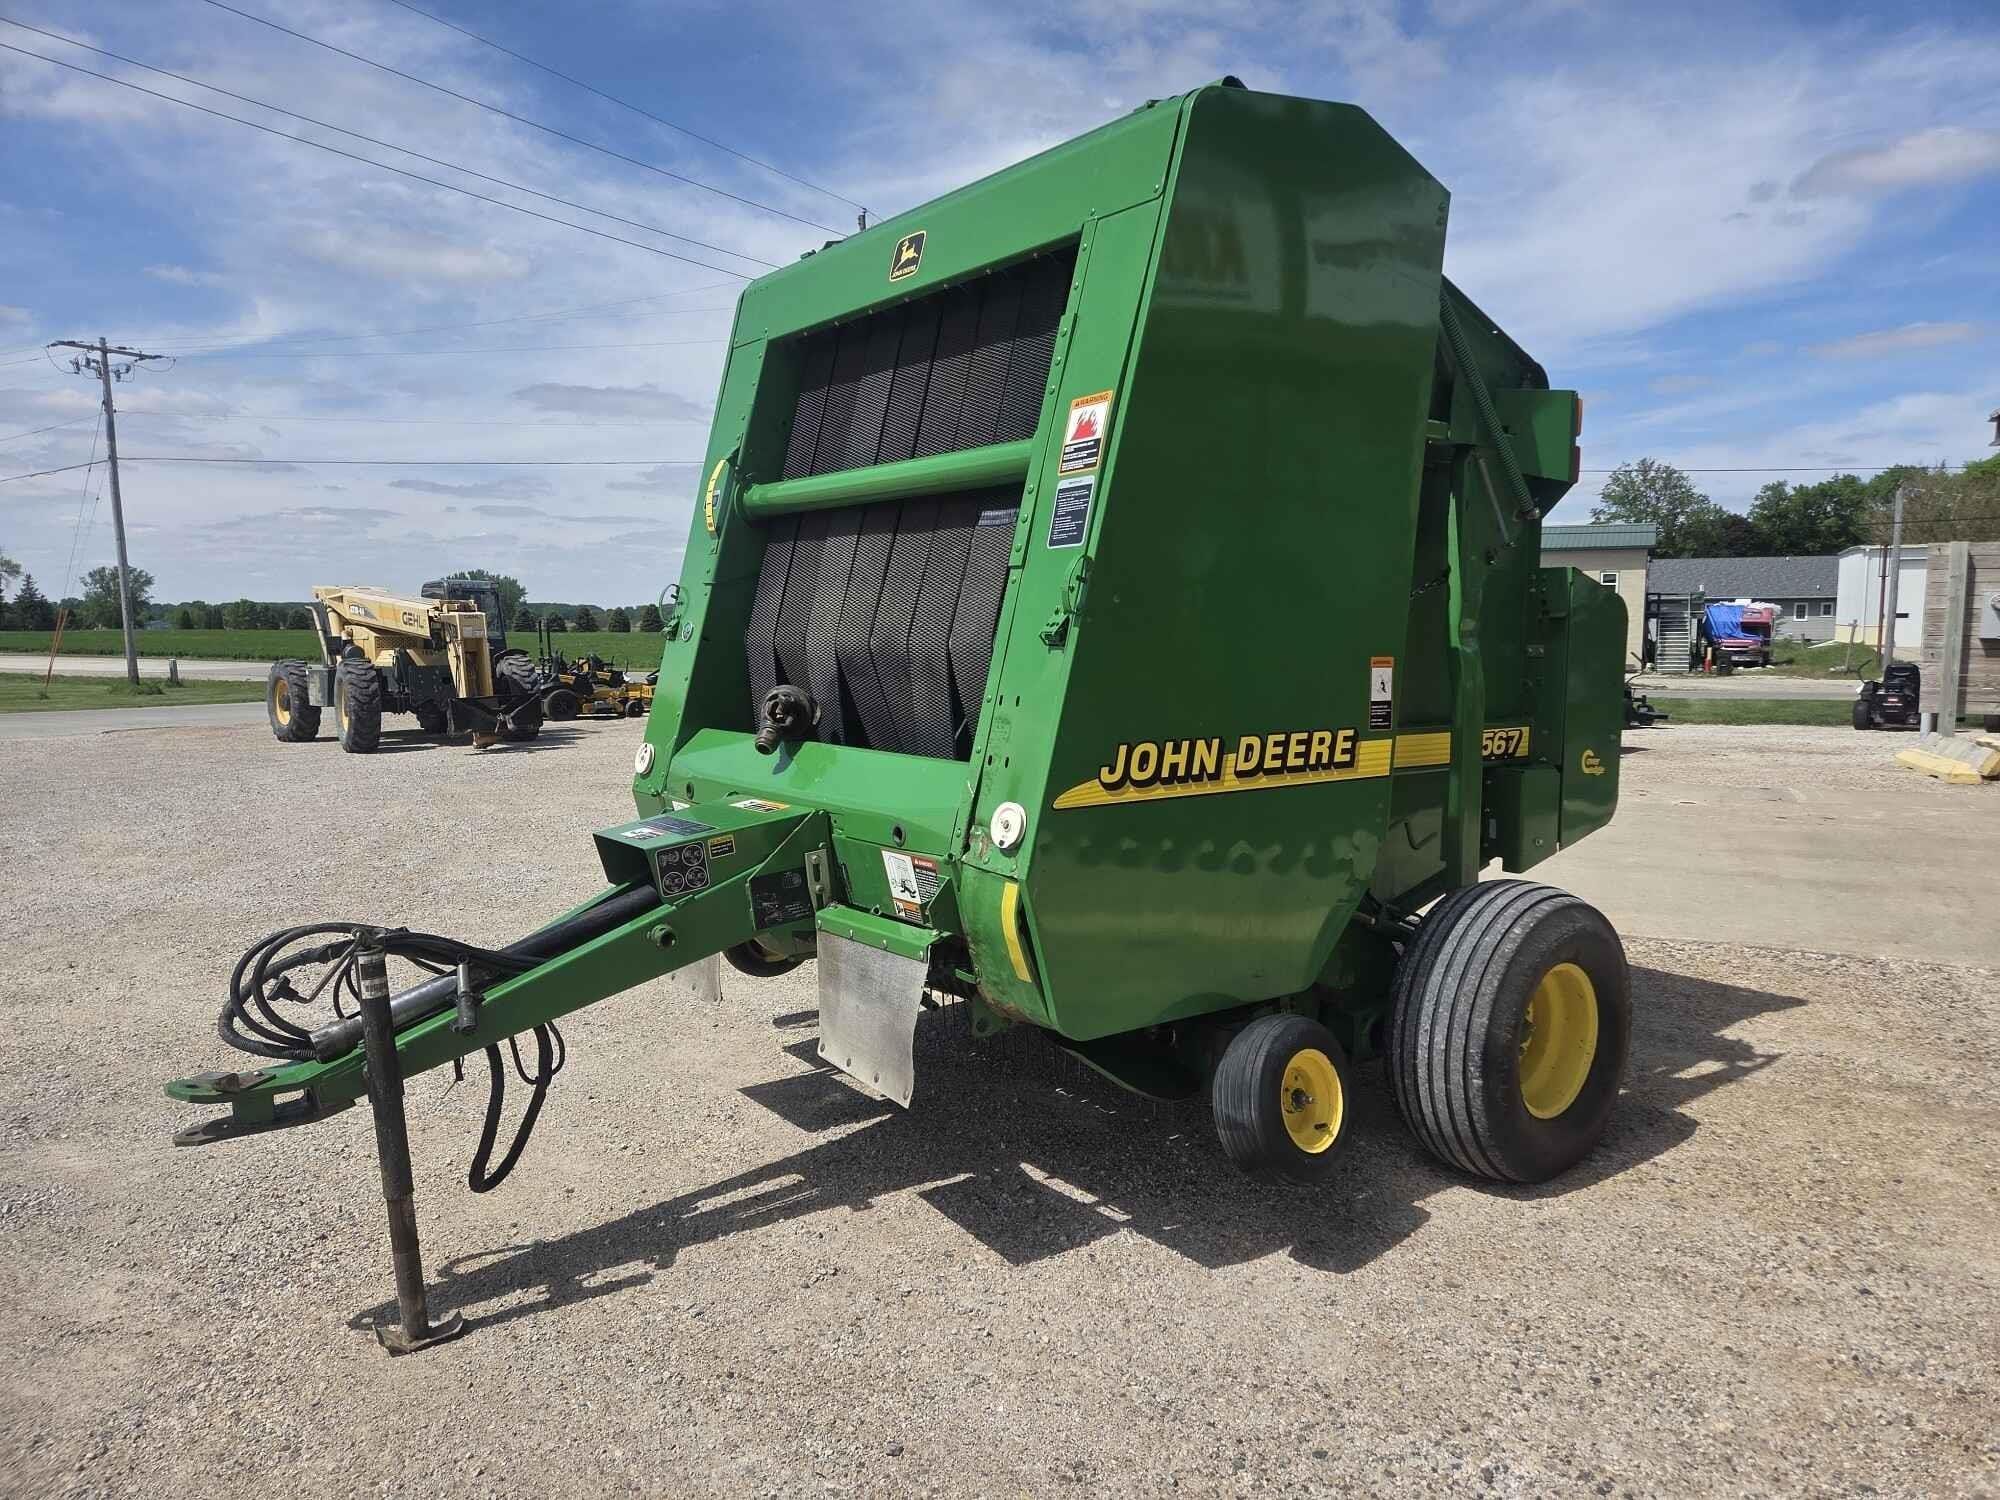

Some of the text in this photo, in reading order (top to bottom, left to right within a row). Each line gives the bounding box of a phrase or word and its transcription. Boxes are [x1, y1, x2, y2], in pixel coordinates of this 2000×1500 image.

[402, 611, 425, 629] GEHL
[1481, 729, 1522, 757] 567
[1099, 728, 1356, 790] JOHN DEERE
